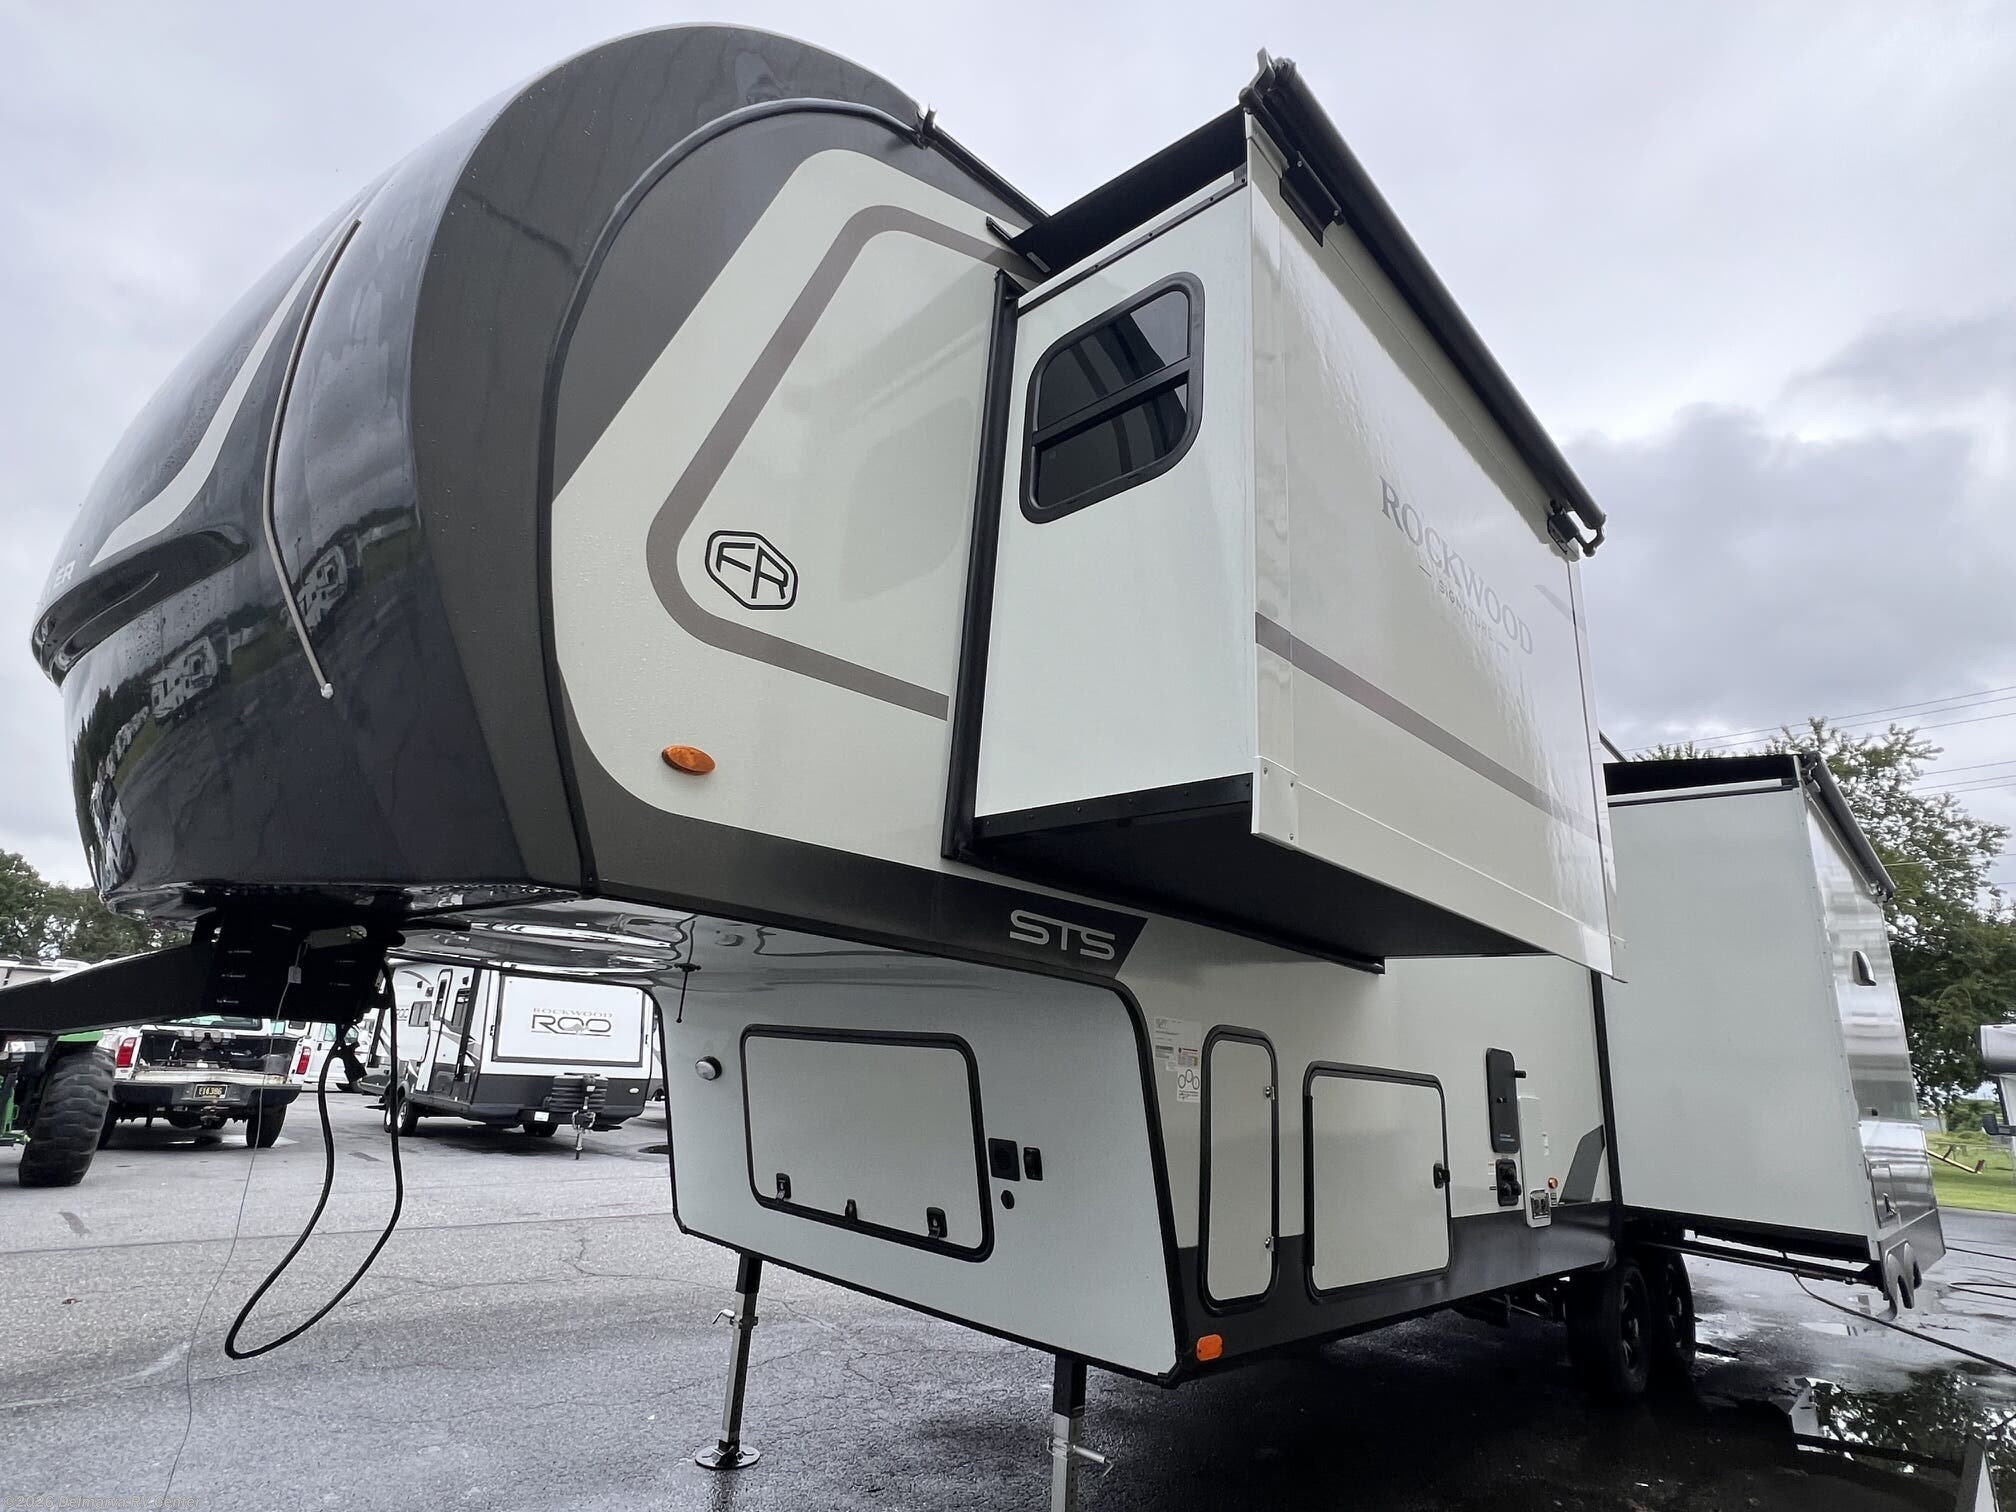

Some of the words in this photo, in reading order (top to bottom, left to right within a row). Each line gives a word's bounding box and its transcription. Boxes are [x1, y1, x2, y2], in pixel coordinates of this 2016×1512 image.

[1380, 475, 1533, 655] ROCKWOOD
[1009, 909, 1115, 961] STS
[531, 1014, 612, 1034] ROO
[533, 1007, 613, 1018] ROCKWOOD
